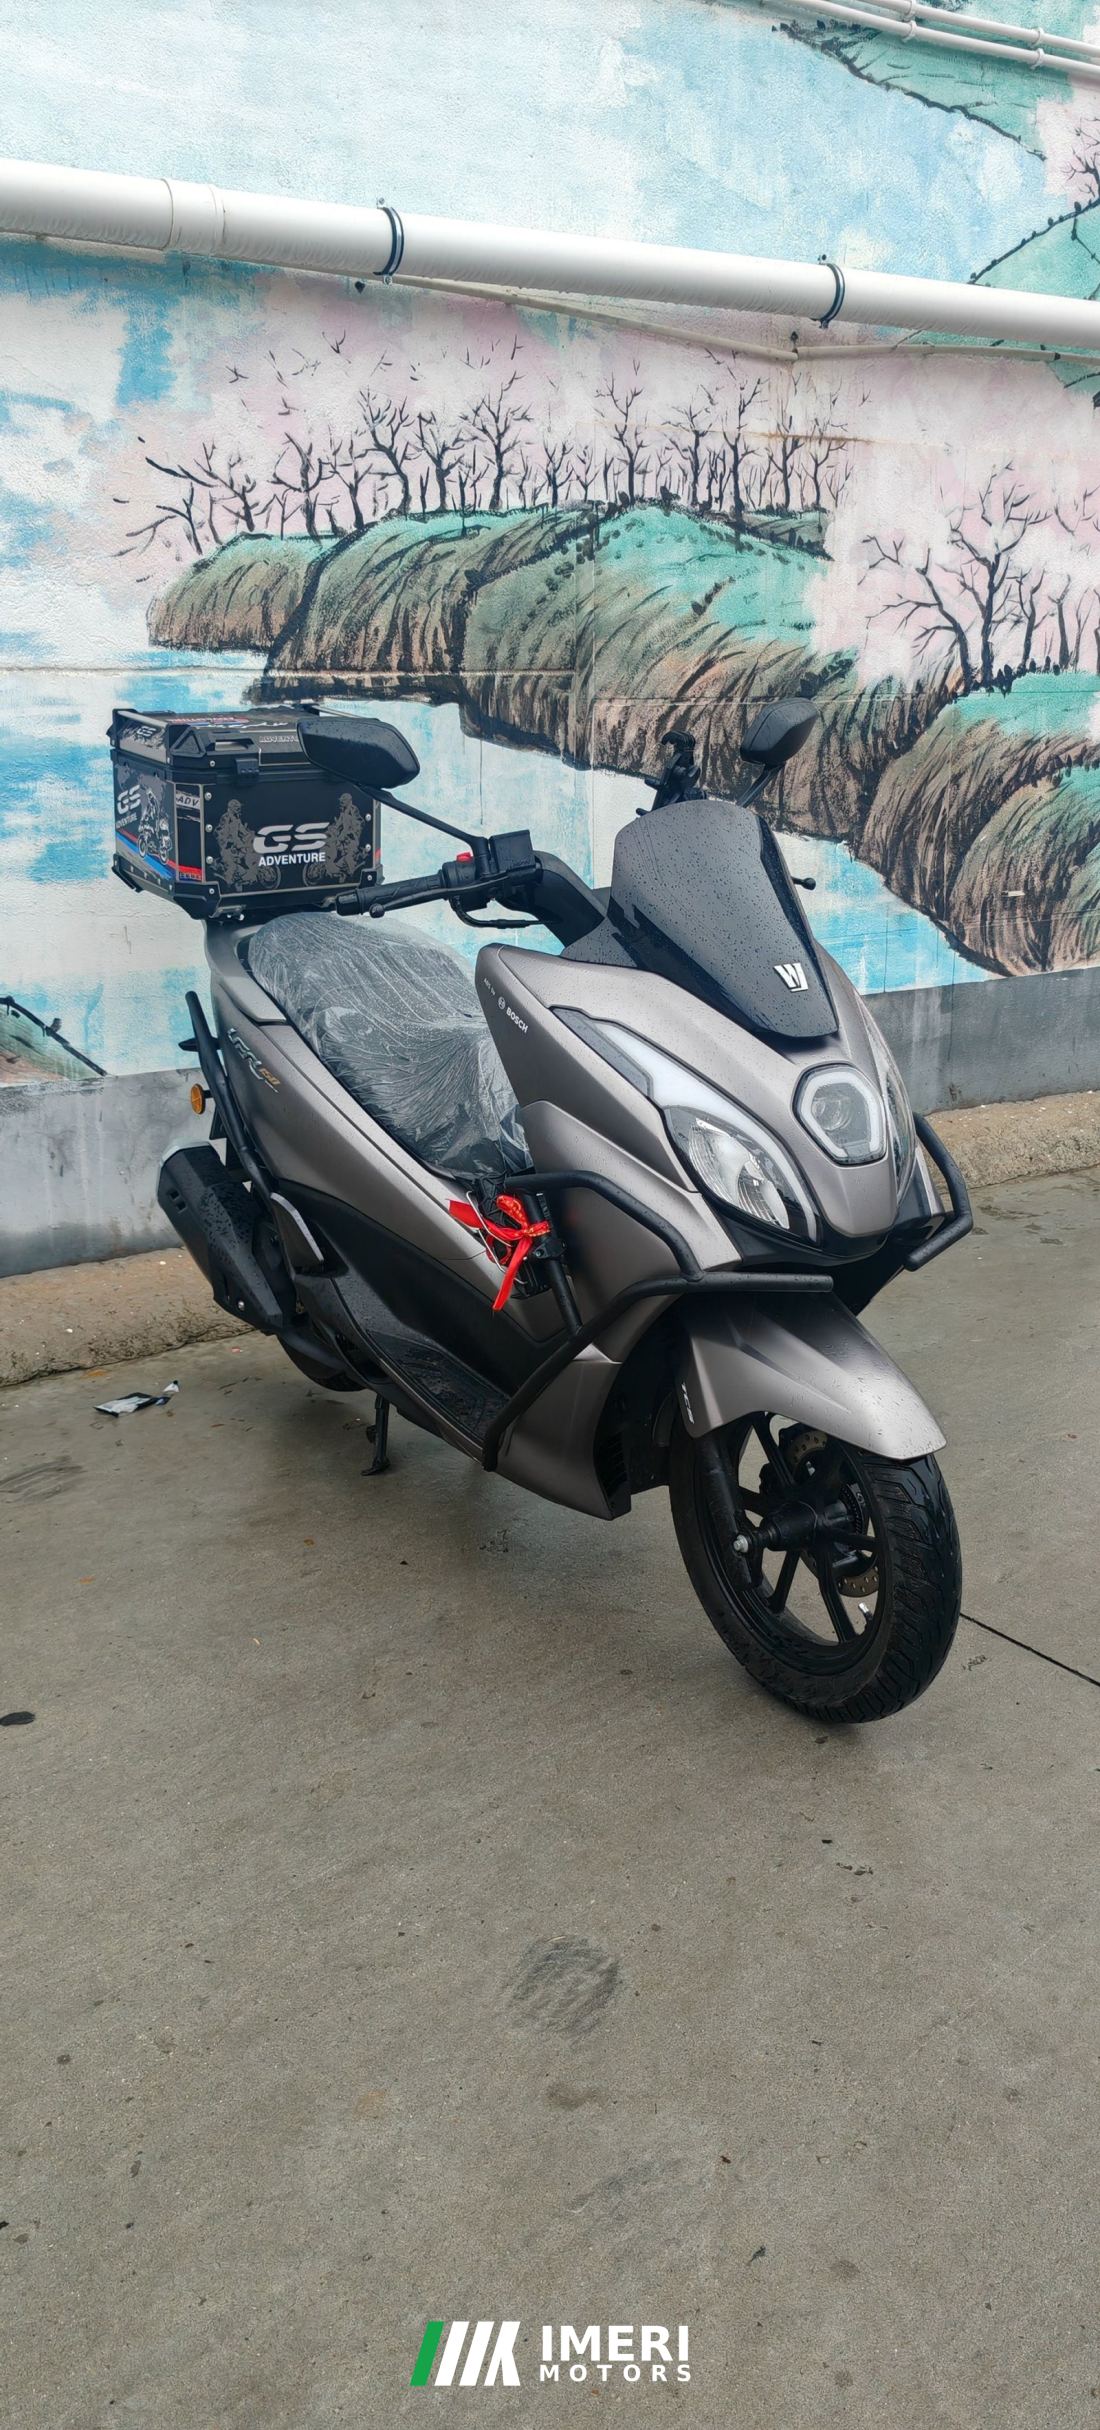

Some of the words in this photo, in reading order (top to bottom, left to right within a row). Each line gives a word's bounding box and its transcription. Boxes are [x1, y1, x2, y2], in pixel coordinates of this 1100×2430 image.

[117, 784, 141, 815] GS
[253, 822, 330, 854] GS
[258, 851, 327, 867] ADVENTURE
[506, 1006, 529, 1033] BOSCH
